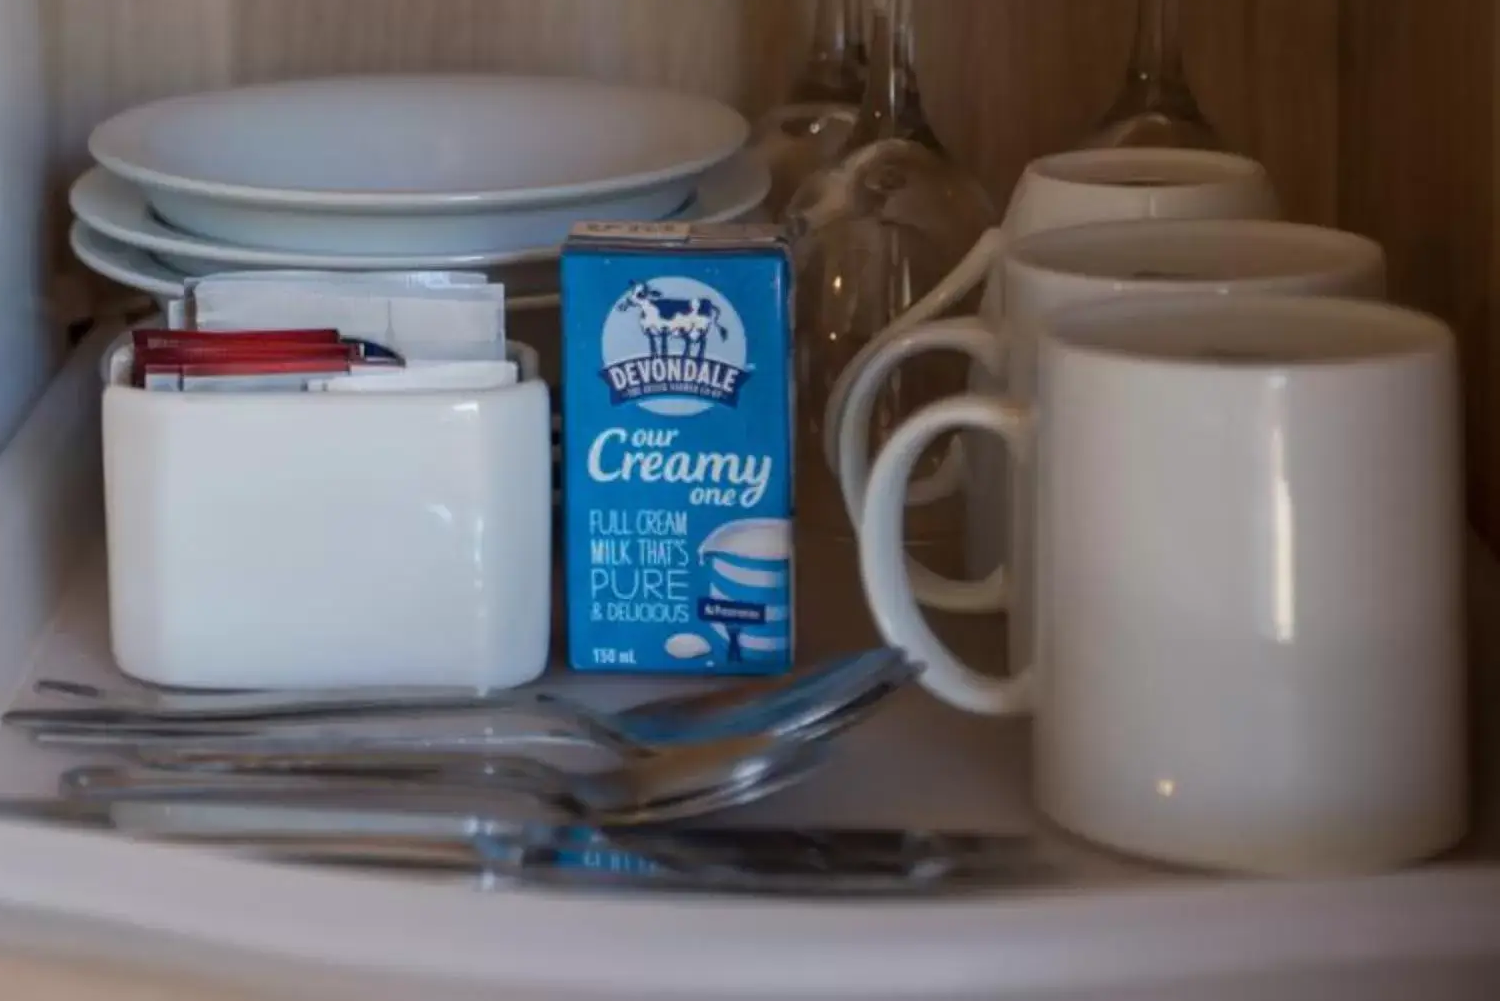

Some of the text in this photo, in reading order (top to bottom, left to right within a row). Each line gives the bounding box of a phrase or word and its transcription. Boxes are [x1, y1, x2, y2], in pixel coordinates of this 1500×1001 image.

[609, 358, 739, 392] DEVONDALE
[632, 429, 678, 447] our
[587, 427, 772, 508] Creamy
[689, 487, 735, 507] one
[589, 510, 688, 535] FULL CREAM
[590, 540, 689, 566] MILK THAT'S
[591, 569, 691, 600] PURE
[590, 604, 604, 622] &
[607, 603, 689, 622] DELICIOUS
[592, 649, 636, 664] 150 mL
